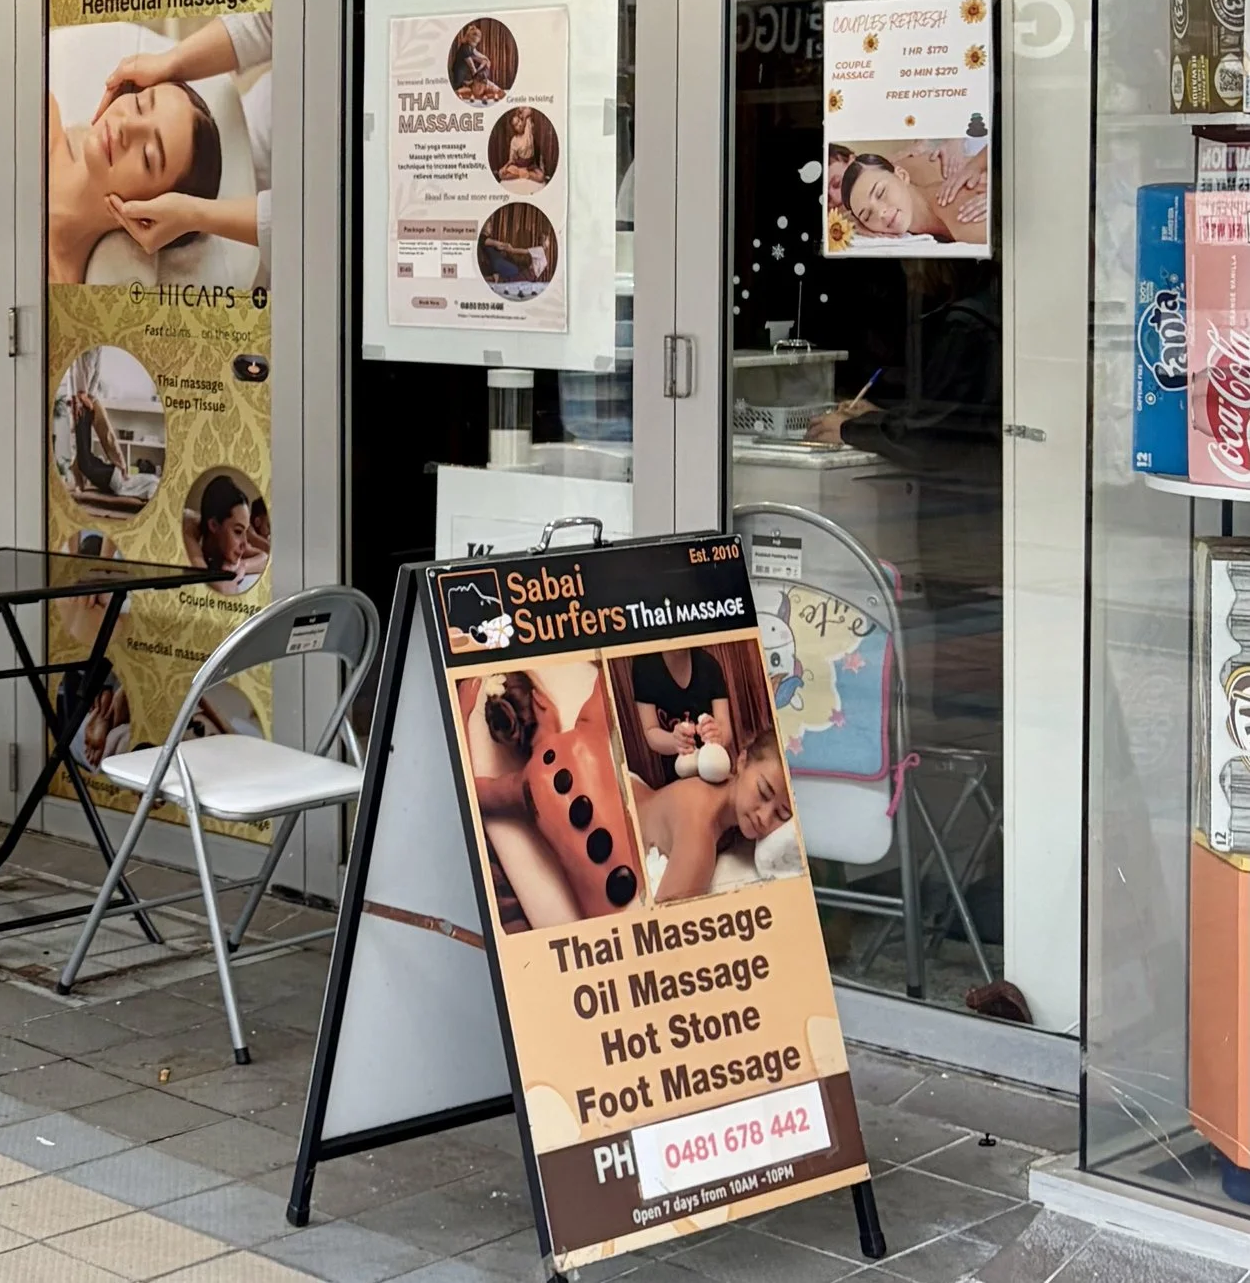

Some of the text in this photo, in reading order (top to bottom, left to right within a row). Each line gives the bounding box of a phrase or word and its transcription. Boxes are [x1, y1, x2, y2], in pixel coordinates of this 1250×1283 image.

[832, 14, 887, 34] COUPLES
[908, 47, 923, 56] HR
[926, 45, 949, 56] $170
[832, 70, 875, 80] MASSAGE
[835, 60, 871, 70] COUPLE
[913, 67, 933, 77] MIN
[935, 66, 958, 77] $270
[398, 92, 440, 112] THAI
[885, 88, 968, 100] FREE HOT STONE
[398, 112, 484, 134] MASSAGE
[409, 153, 433, 161] Massage
[159, 283, 235, 309] HICAPS
[145, 325, 163, 336] Fast
[215, 328, 229, 339] the
[157, 374, 224, 394] Thai massage
[165, 396, 226, 412] Deep Tissue
[689, 544, 739, 564] Est. 2010
[507, 564, 584, 605] Sabai
[179, 591, 215, 611] Couple
[515, 597, 744, 644] Surfers Thai MASSAGE
[127, 637, 210, 663] Remedial massa
[549, 904, 773, 973] Thai Massage
[573, 954, 770, 1020] Oil Massage
[601, 1005, 761, 1066] Hot Stone
[576, 1045, 801, 1124] Foot Massage
[593, 1107, 810, 1184] PH 0481 678 442
[632, 1204, 662, 1227] Open
[662, 1200, 671, 1215] 7
[673, 1193, 699, 1214] days
[701, 1184, 727, 1203] from
[729, 1175, 758, 1195] 10AM
